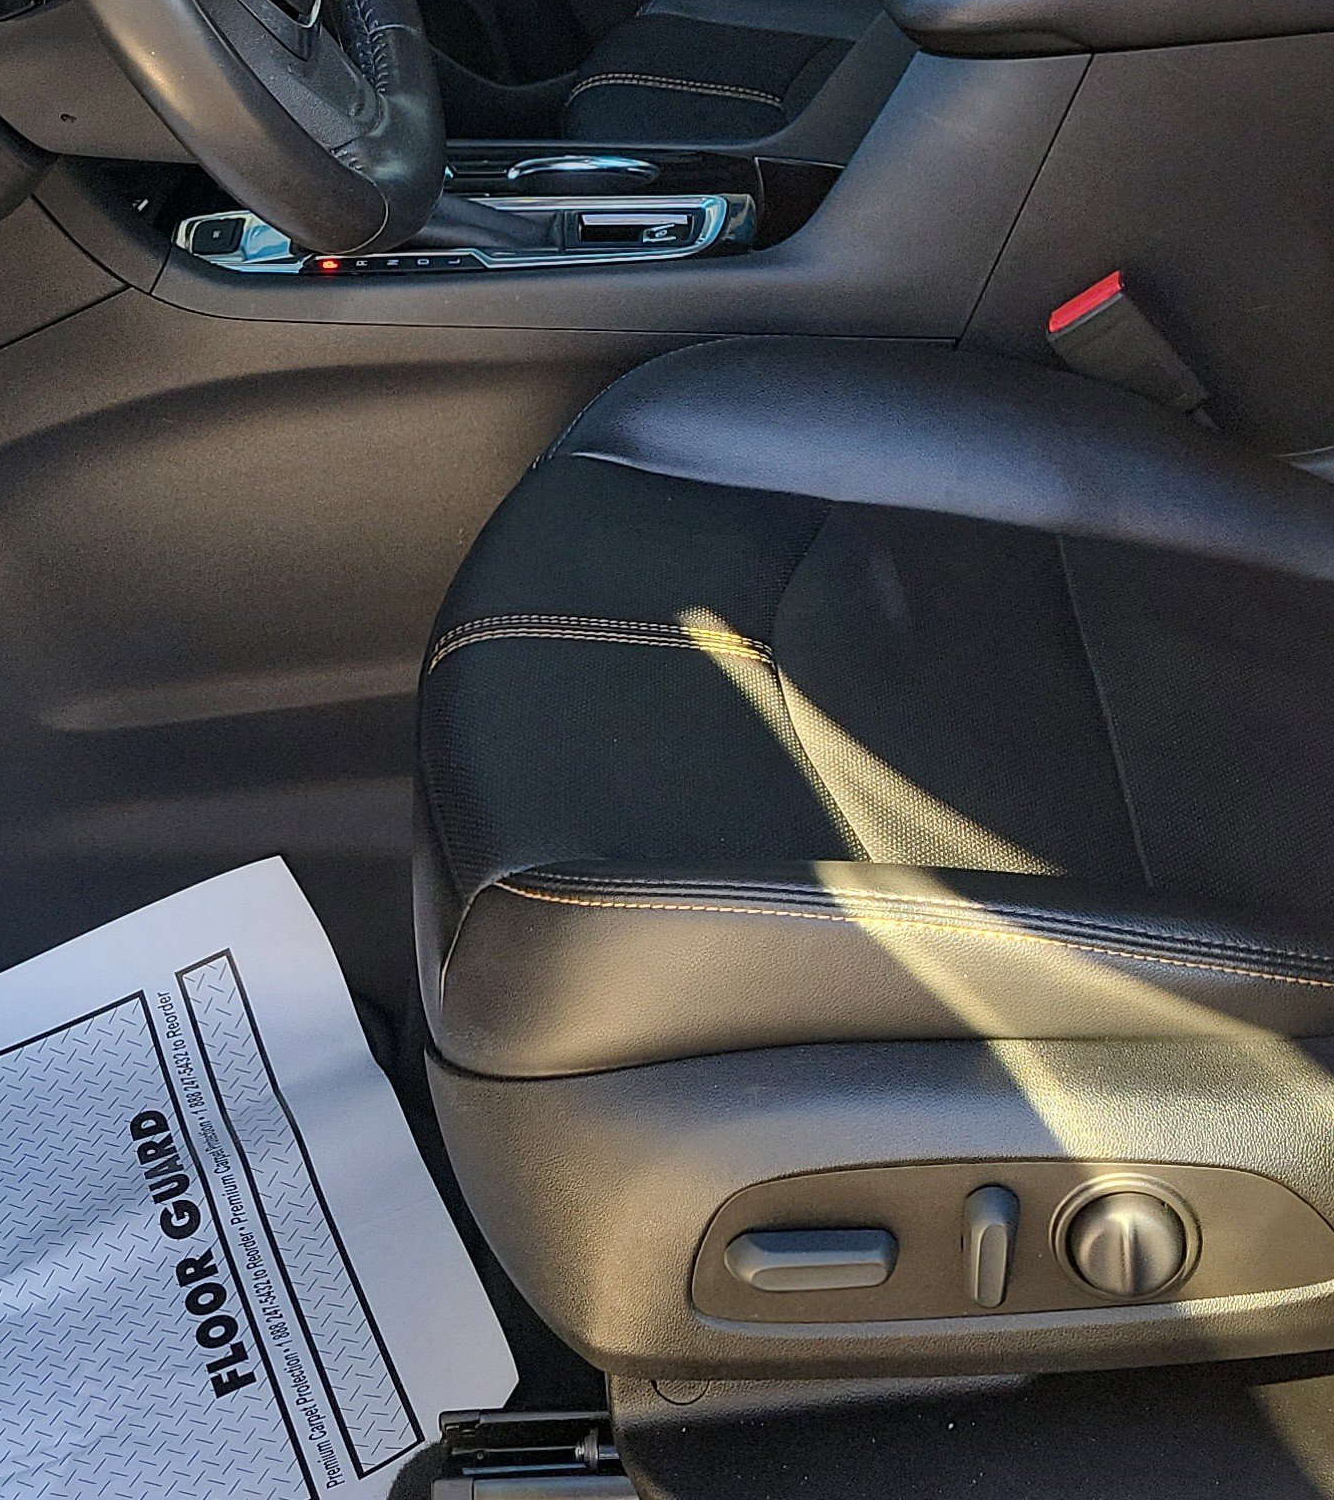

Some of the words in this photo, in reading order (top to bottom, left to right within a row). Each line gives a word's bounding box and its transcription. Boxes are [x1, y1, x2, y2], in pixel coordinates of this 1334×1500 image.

[157, 991, 183, 1039] Reorder
[172, 1037, 183, 1051] to
[173, 1050, 201, 1092] 247-5432
[186, 1091, 205, 1109] 888
[129, 1109, 202, 1240] GUARD
[221, 1174, 249, 1226] Premium
[238, 1231, 265, 1270] Reorder
[253, 1268, 267, 1281] to
[253, 1278, 285, 1323] 247-5432
[175, 1247, 258, 1399] FLOOR
[268, 1320, 292, 1341] 888
[282, 1351, 315, 1406] Protection
[304, 1405, 328, 1442] Carpet
[317, 1441, 346, 1489] Premium
